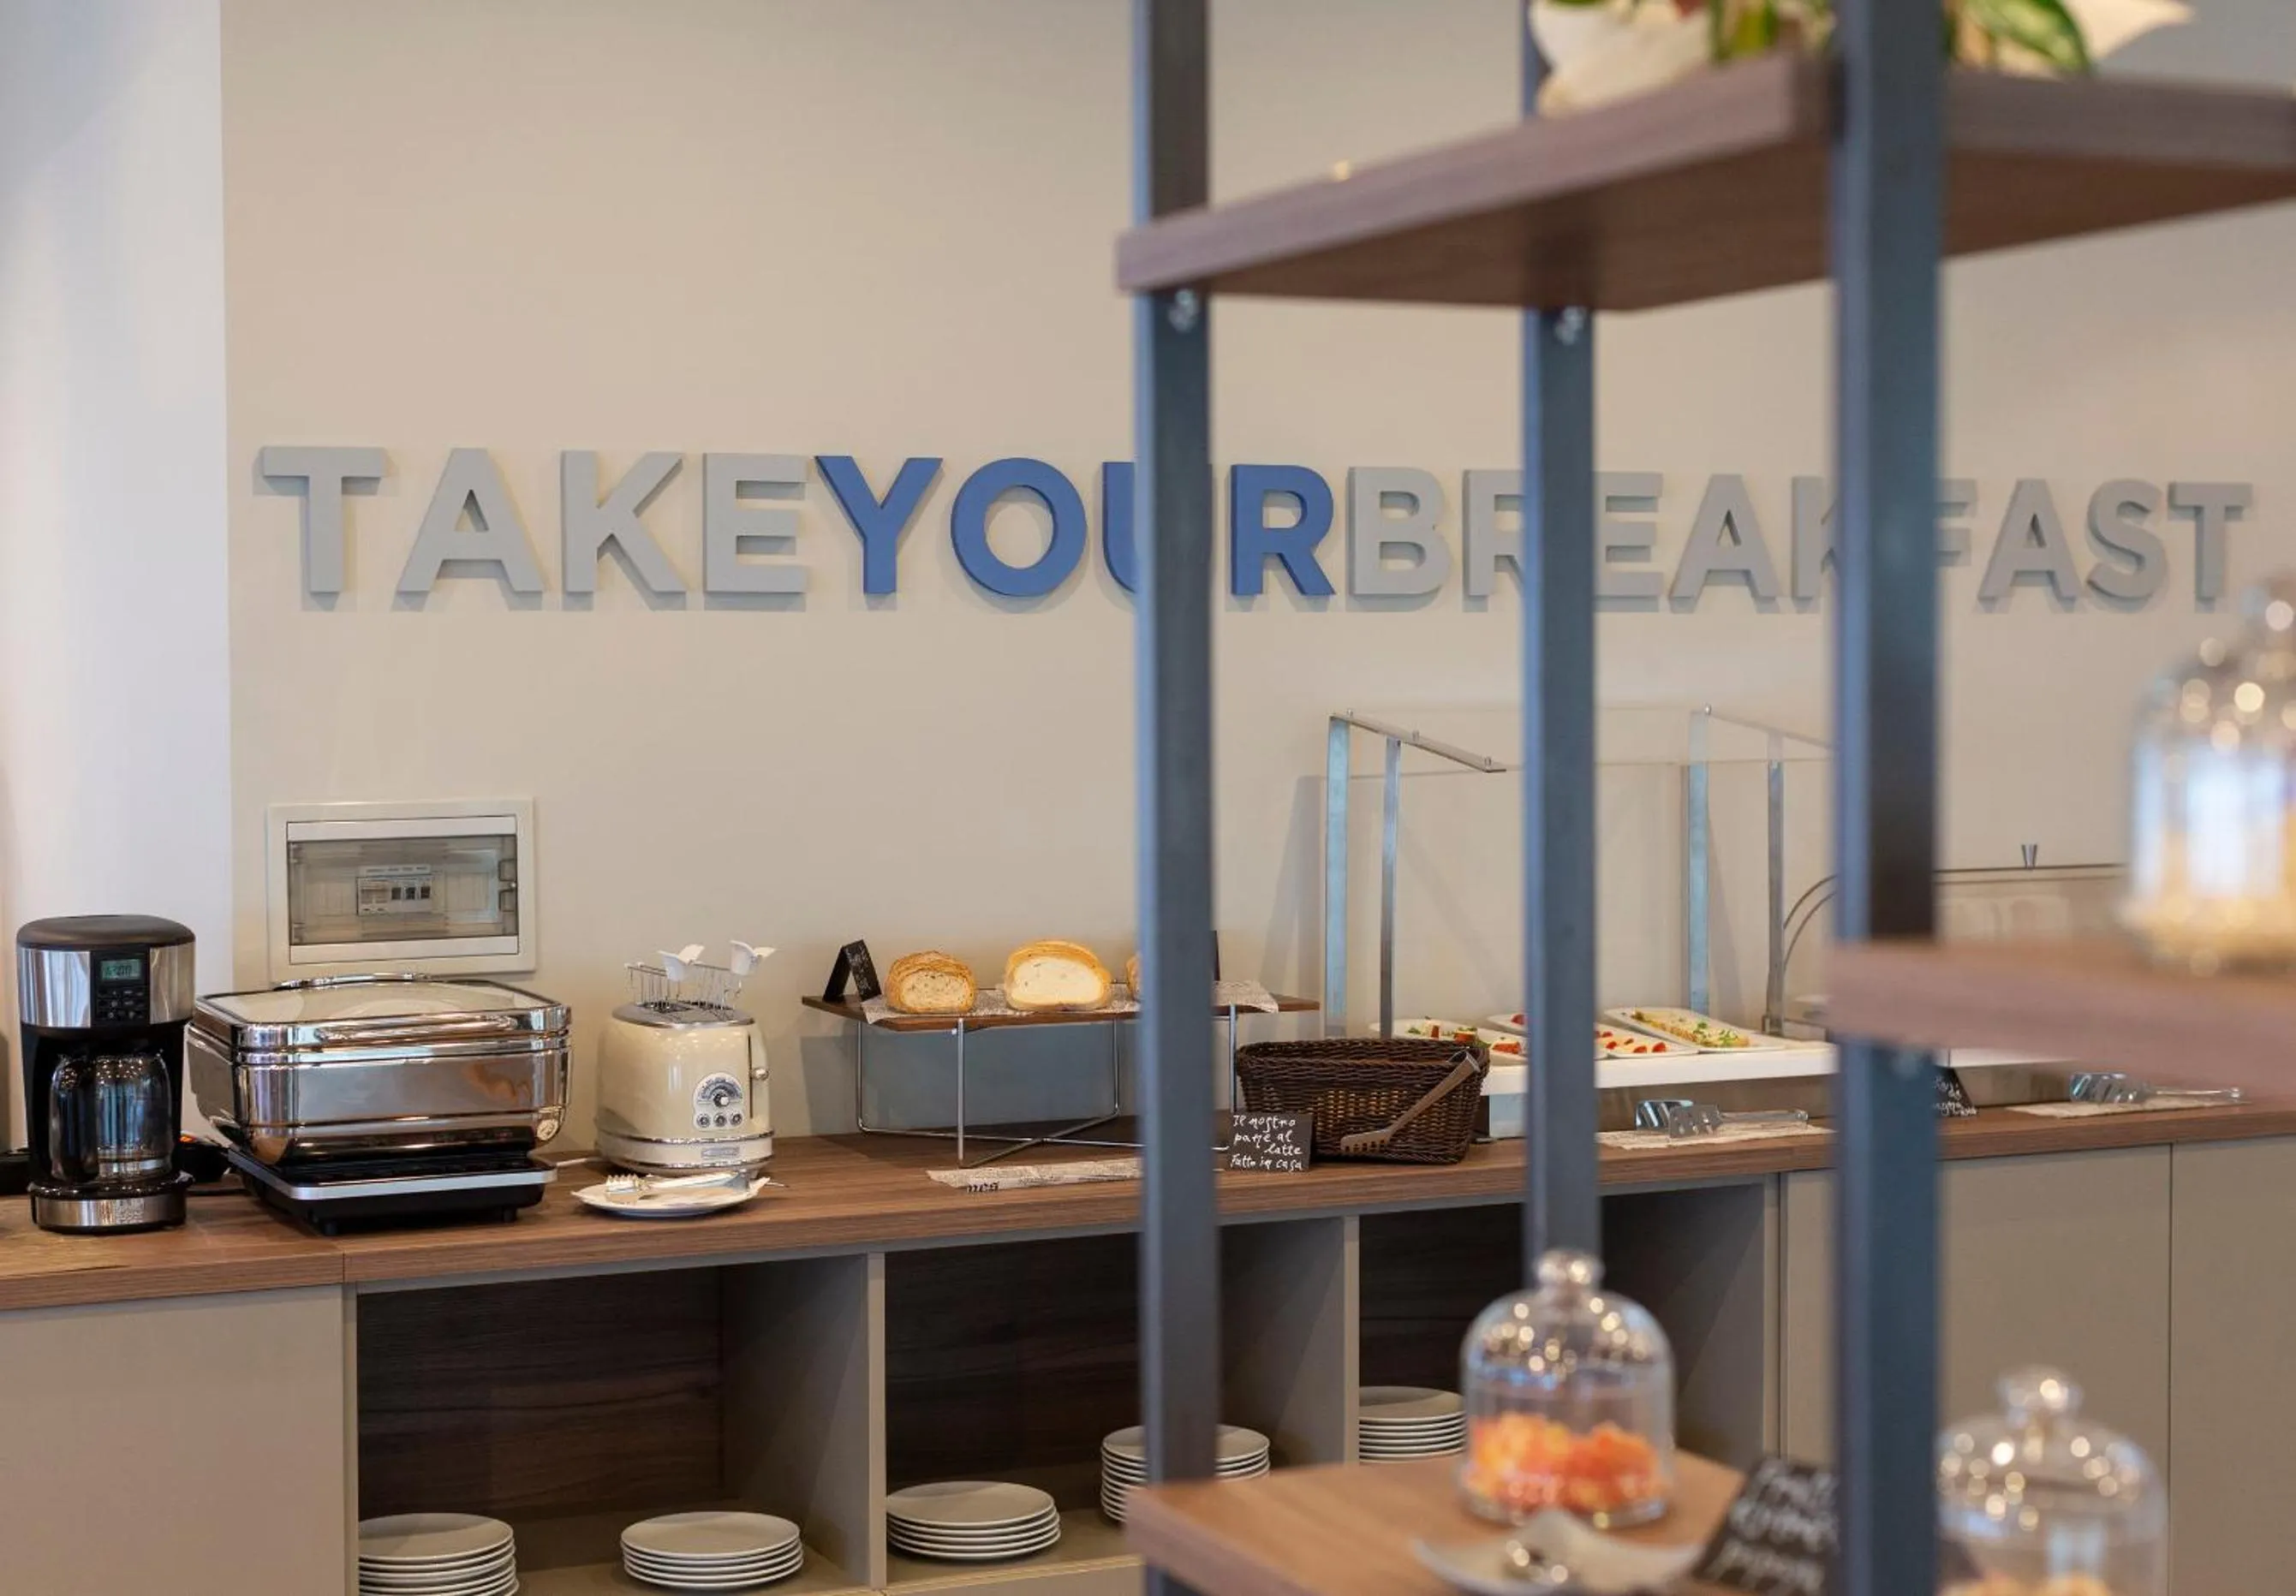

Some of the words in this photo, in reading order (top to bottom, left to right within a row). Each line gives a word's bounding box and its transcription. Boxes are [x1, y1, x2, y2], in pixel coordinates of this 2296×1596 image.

[260, 446, 808, 596] TAKE
[1249, 1116, 1296, 1133] nostro
[1233, 1133, 1271, 1148] pane
[1277, 1129, 1292, 1143] al
[1259, 1156, 1273, 1170] in
[1276, 1159, 1303, 1172] casa
